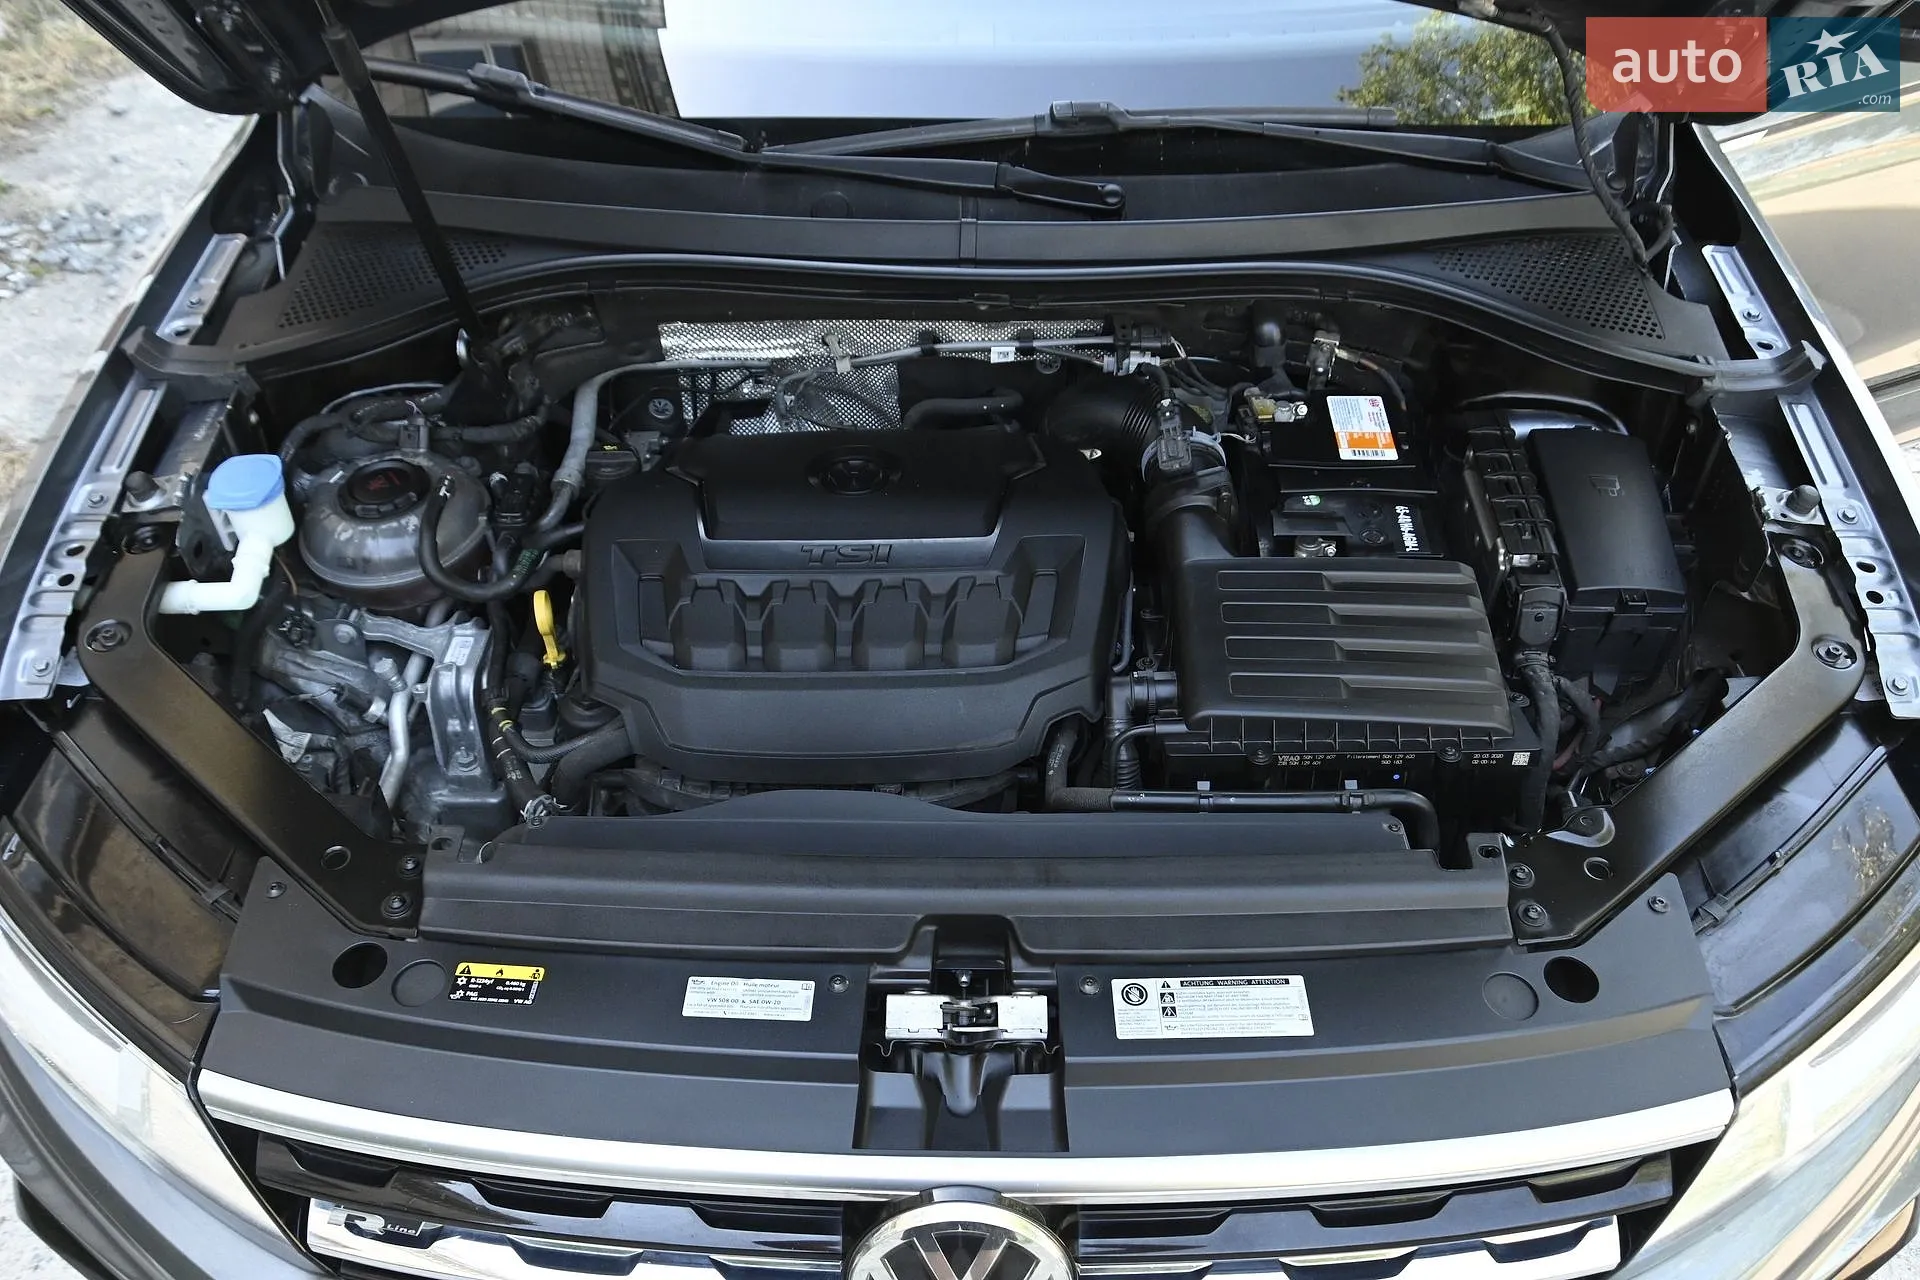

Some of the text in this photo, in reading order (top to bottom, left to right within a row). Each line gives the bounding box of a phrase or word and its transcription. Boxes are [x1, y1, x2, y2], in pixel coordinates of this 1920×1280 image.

[801, 544, 893, 566] TSI
[710, 980, 730, 988] Engine
[387, 1223, 416, 1234] Line
